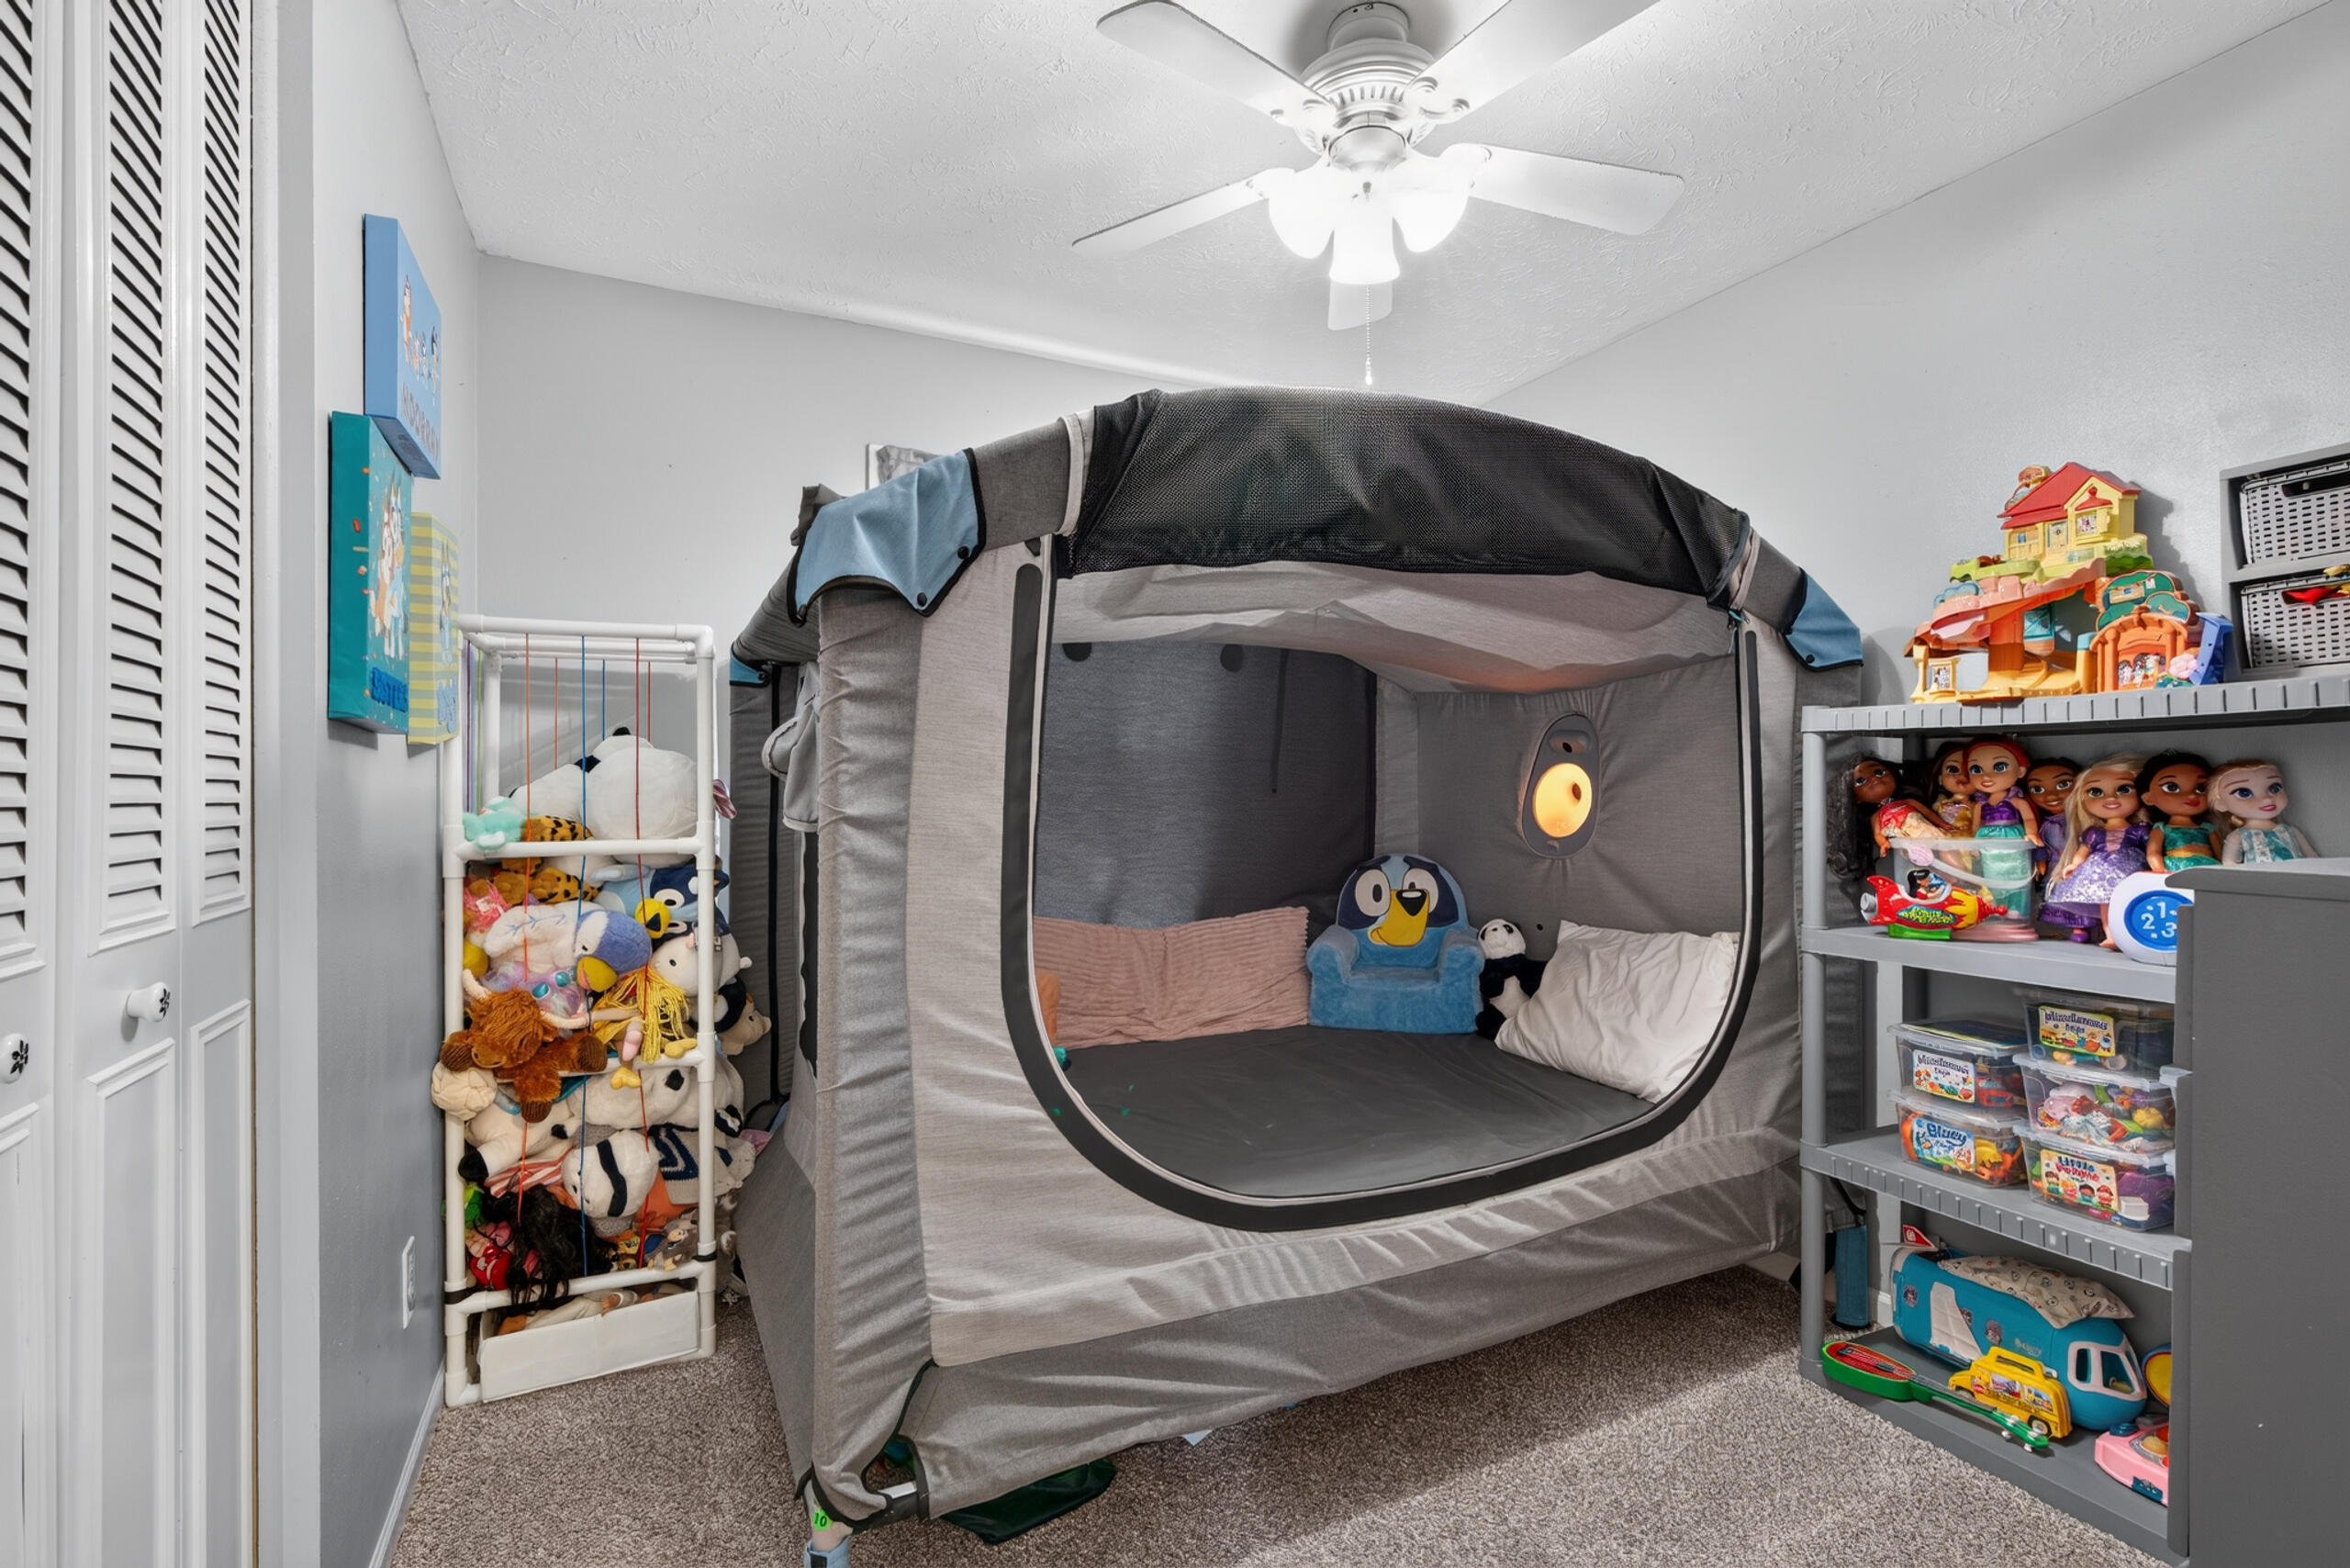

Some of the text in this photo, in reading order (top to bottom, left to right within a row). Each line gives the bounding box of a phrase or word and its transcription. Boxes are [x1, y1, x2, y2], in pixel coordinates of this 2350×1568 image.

[2156, 902, 2165, 919] 1
[2141, 913, 2155, 930] 2
[2161, 922, 2177, 938] 3
[1927, 1123, 1967, 1147] Bluey
[814, 1512, 828, 1528] 10
